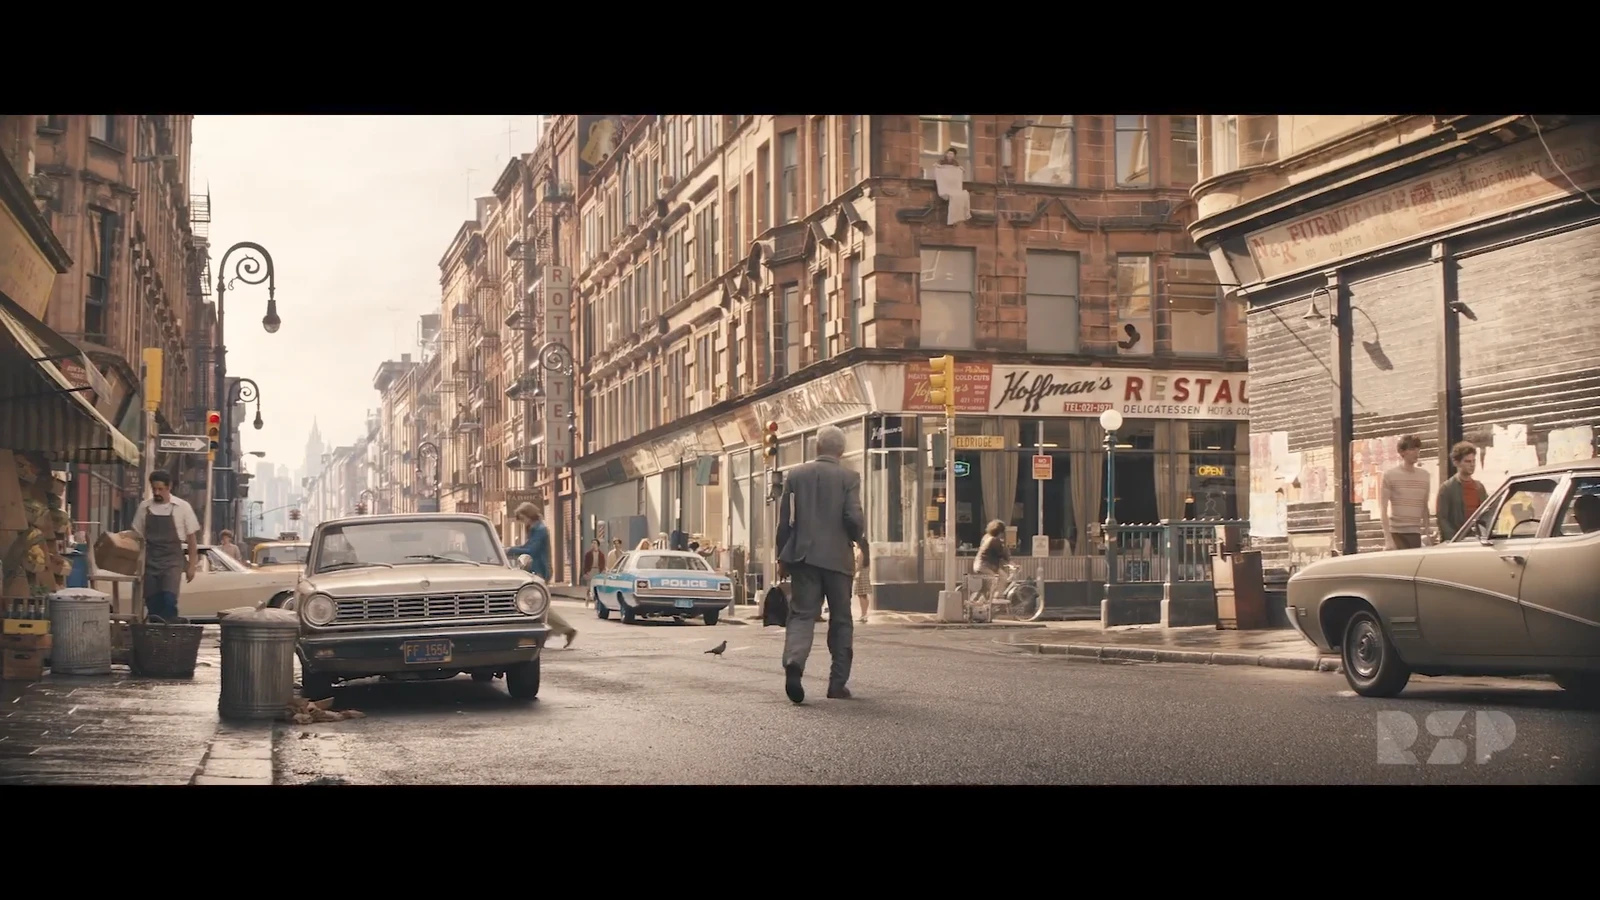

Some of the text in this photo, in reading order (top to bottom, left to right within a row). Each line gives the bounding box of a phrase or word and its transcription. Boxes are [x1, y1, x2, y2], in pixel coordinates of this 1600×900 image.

[994, 371, 1113, 413] Hoffman's
[1123, 404, 1200, 415] DELICATESSEN
[1207, 406, 1225, 416] HOT
[1226, 407, 1233, 416] &
[162, 440, 194, 448] ONE WAY
[956, 436, 992, 447] ELDRIDGE
[1198, 465, 1224, 476] OPEN
[661, 579, 708, 588] POLICE
[406, 644, 420, 657] FF
